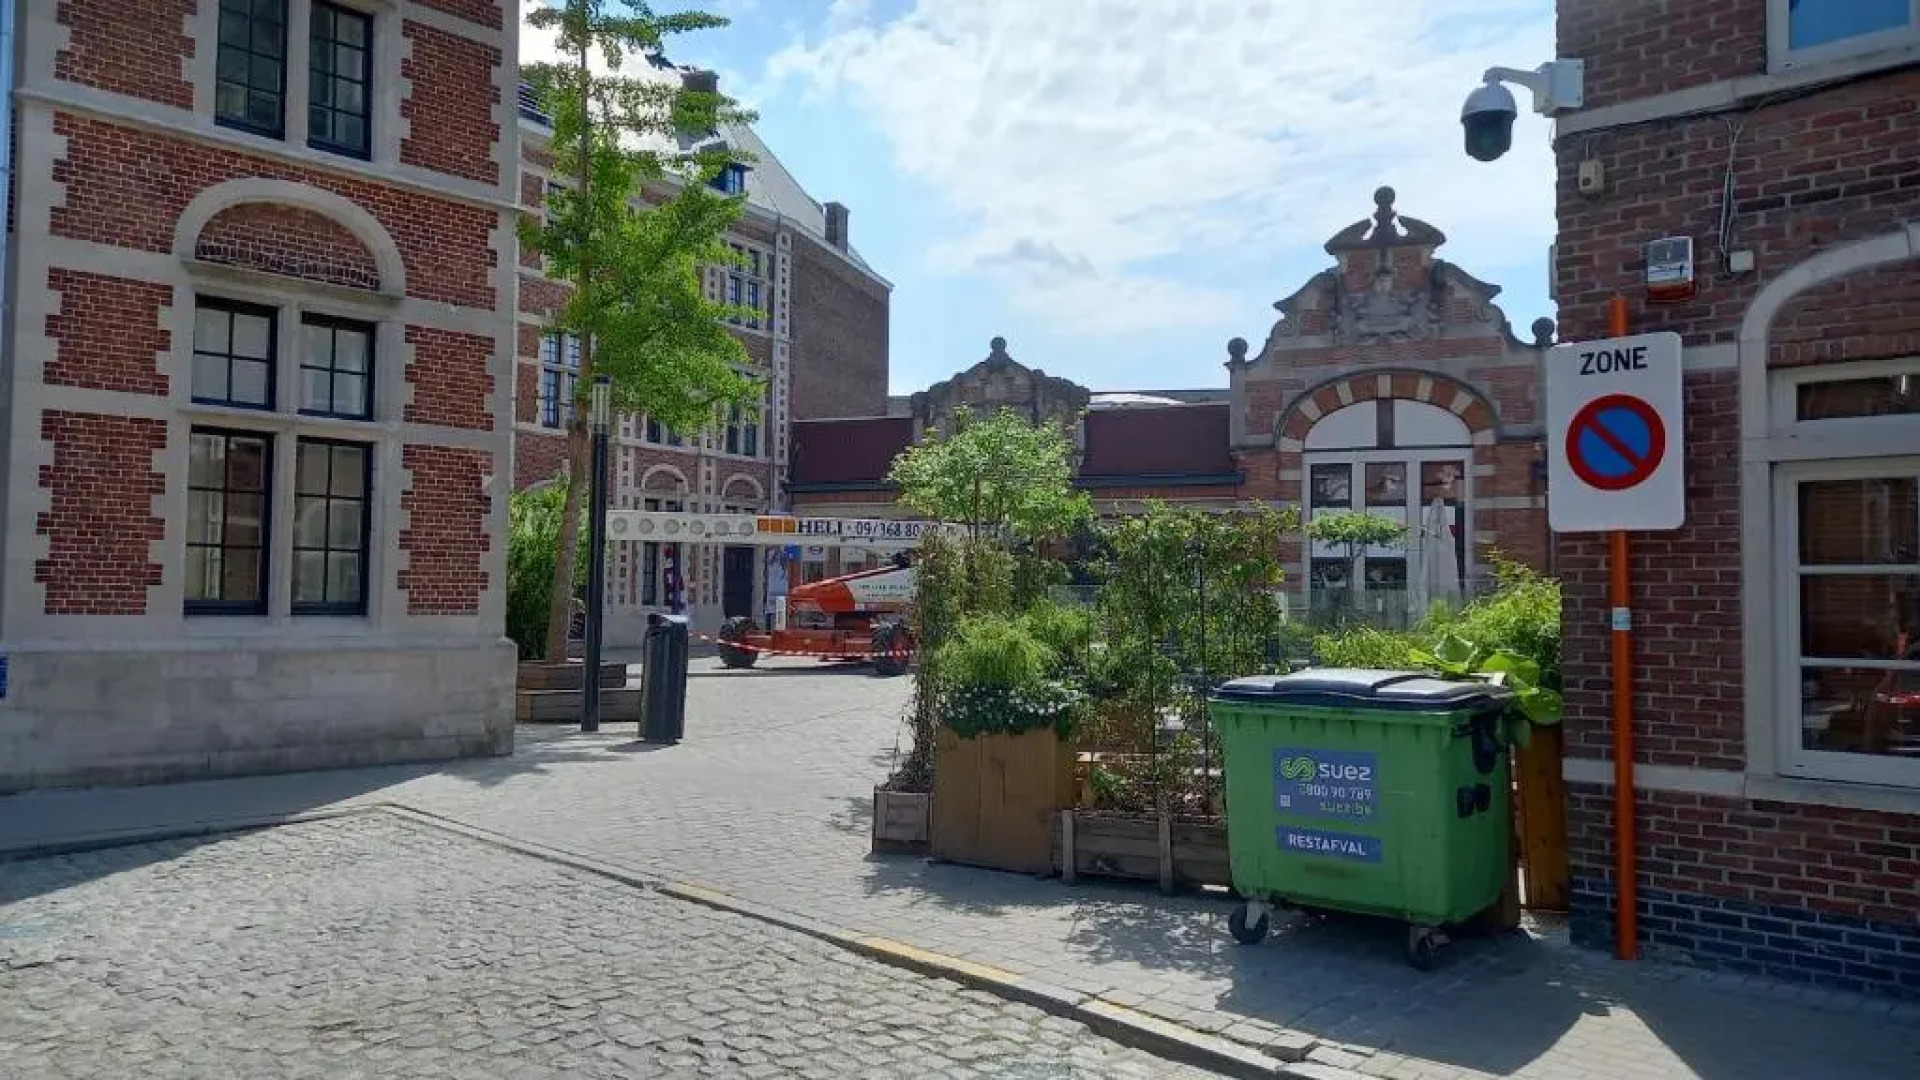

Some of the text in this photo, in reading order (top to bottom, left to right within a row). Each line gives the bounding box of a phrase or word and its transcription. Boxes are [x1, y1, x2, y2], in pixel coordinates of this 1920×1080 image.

[1579, 346, 1648, 376] ZONE
[798, 520, 842, 535] HELI
[856, 521, 901, 537] 09/368
[905, 522, 920, 537] 80
[1331, 786, 1345, 798] 90
[1349, 787, 1372, 800] 789
[1288, 833, 1366, 856] RESTAFVAL
